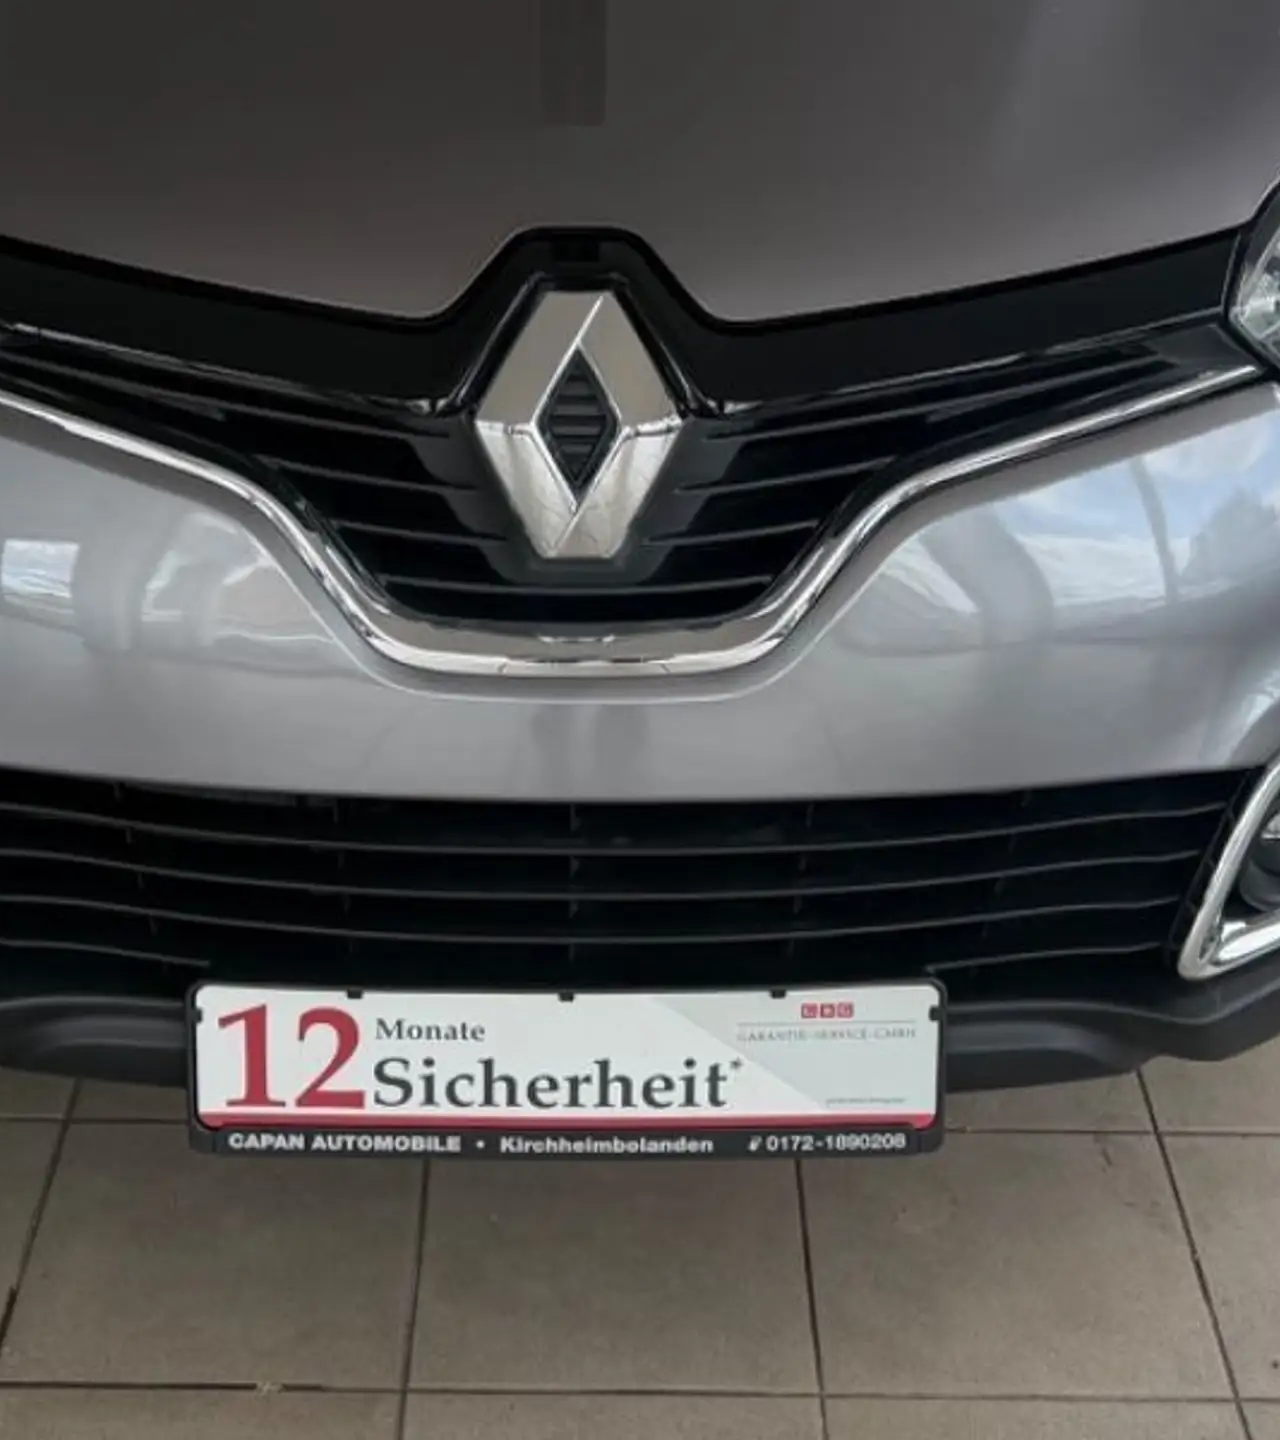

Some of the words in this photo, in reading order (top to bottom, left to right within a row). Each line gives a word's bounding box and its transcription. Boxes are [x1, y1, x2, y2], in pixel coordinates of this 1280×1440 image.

[218, 1003, 366, 1109] 12
[376, 1018, 486, 1043] Monate
[228, 1132, 305, 1152] CAPAN
[311, 1134, 462, 1153] AUTOMOBILE
[500, 1135, 714, 1155] Kirchheimbolanden
